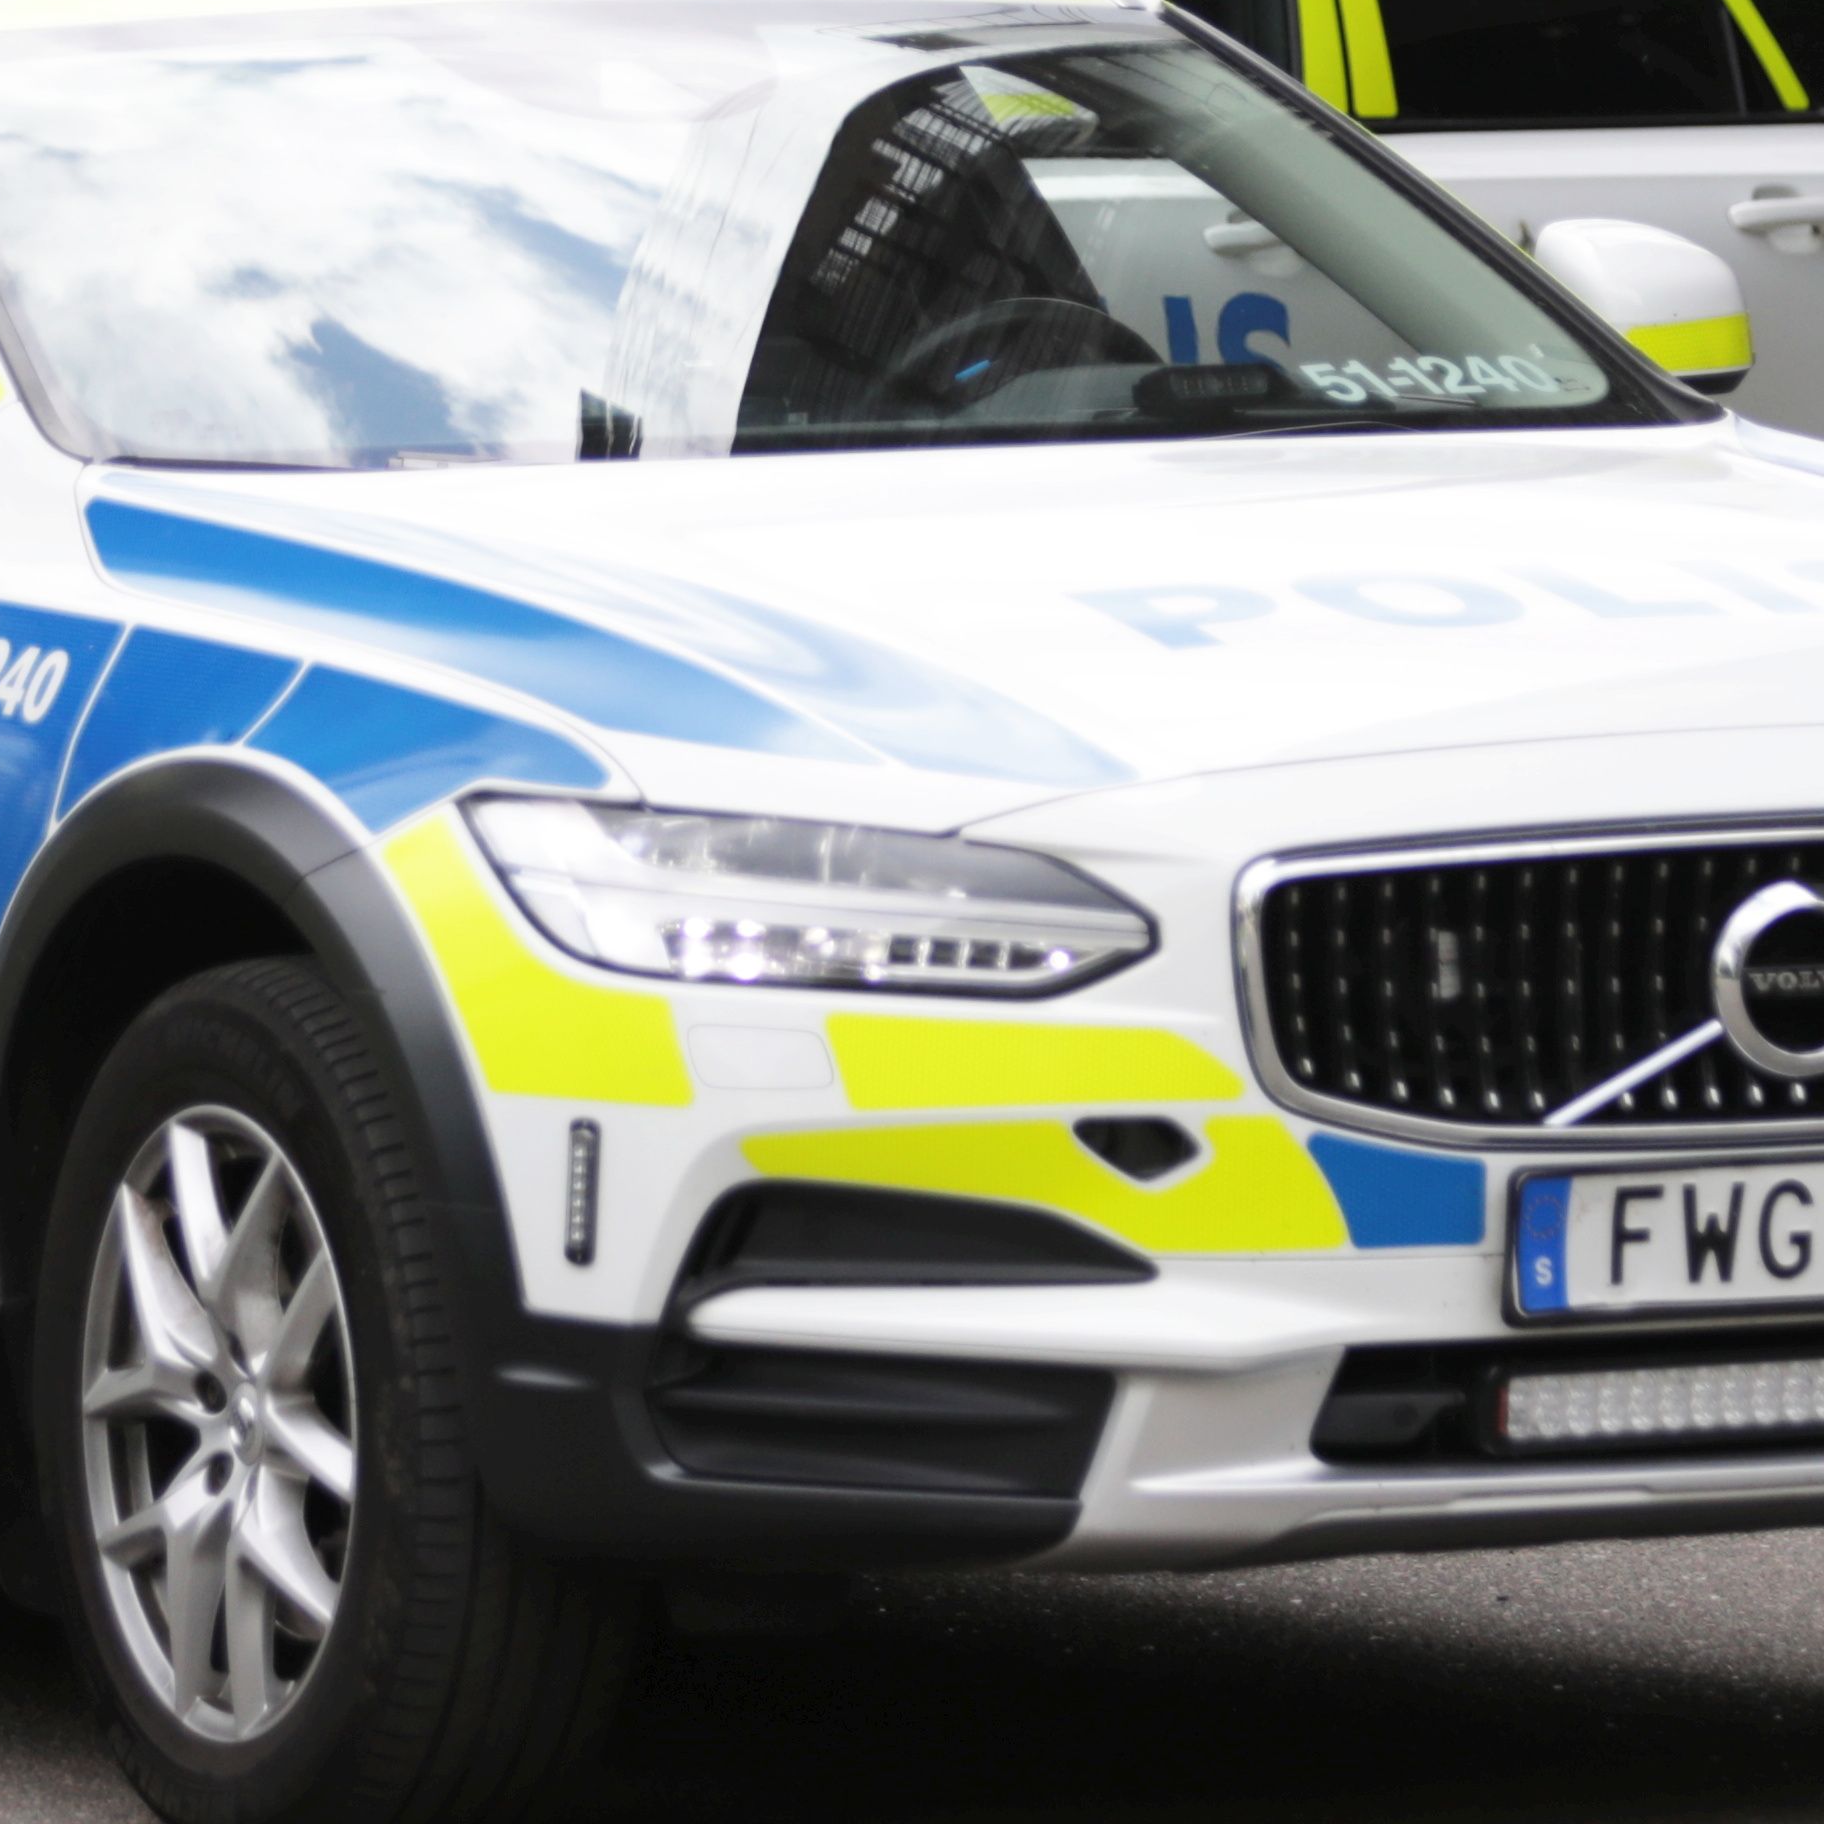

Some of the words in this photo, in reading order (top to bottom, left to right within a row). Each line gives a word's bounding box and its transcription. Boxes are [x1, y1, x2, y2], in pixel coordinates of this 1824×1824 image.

[1298, 354, 1553, 404] 51-1240
[1610, 1178, 1813, 1285] FWG
[1534, 1257, 1552, 1286] S
